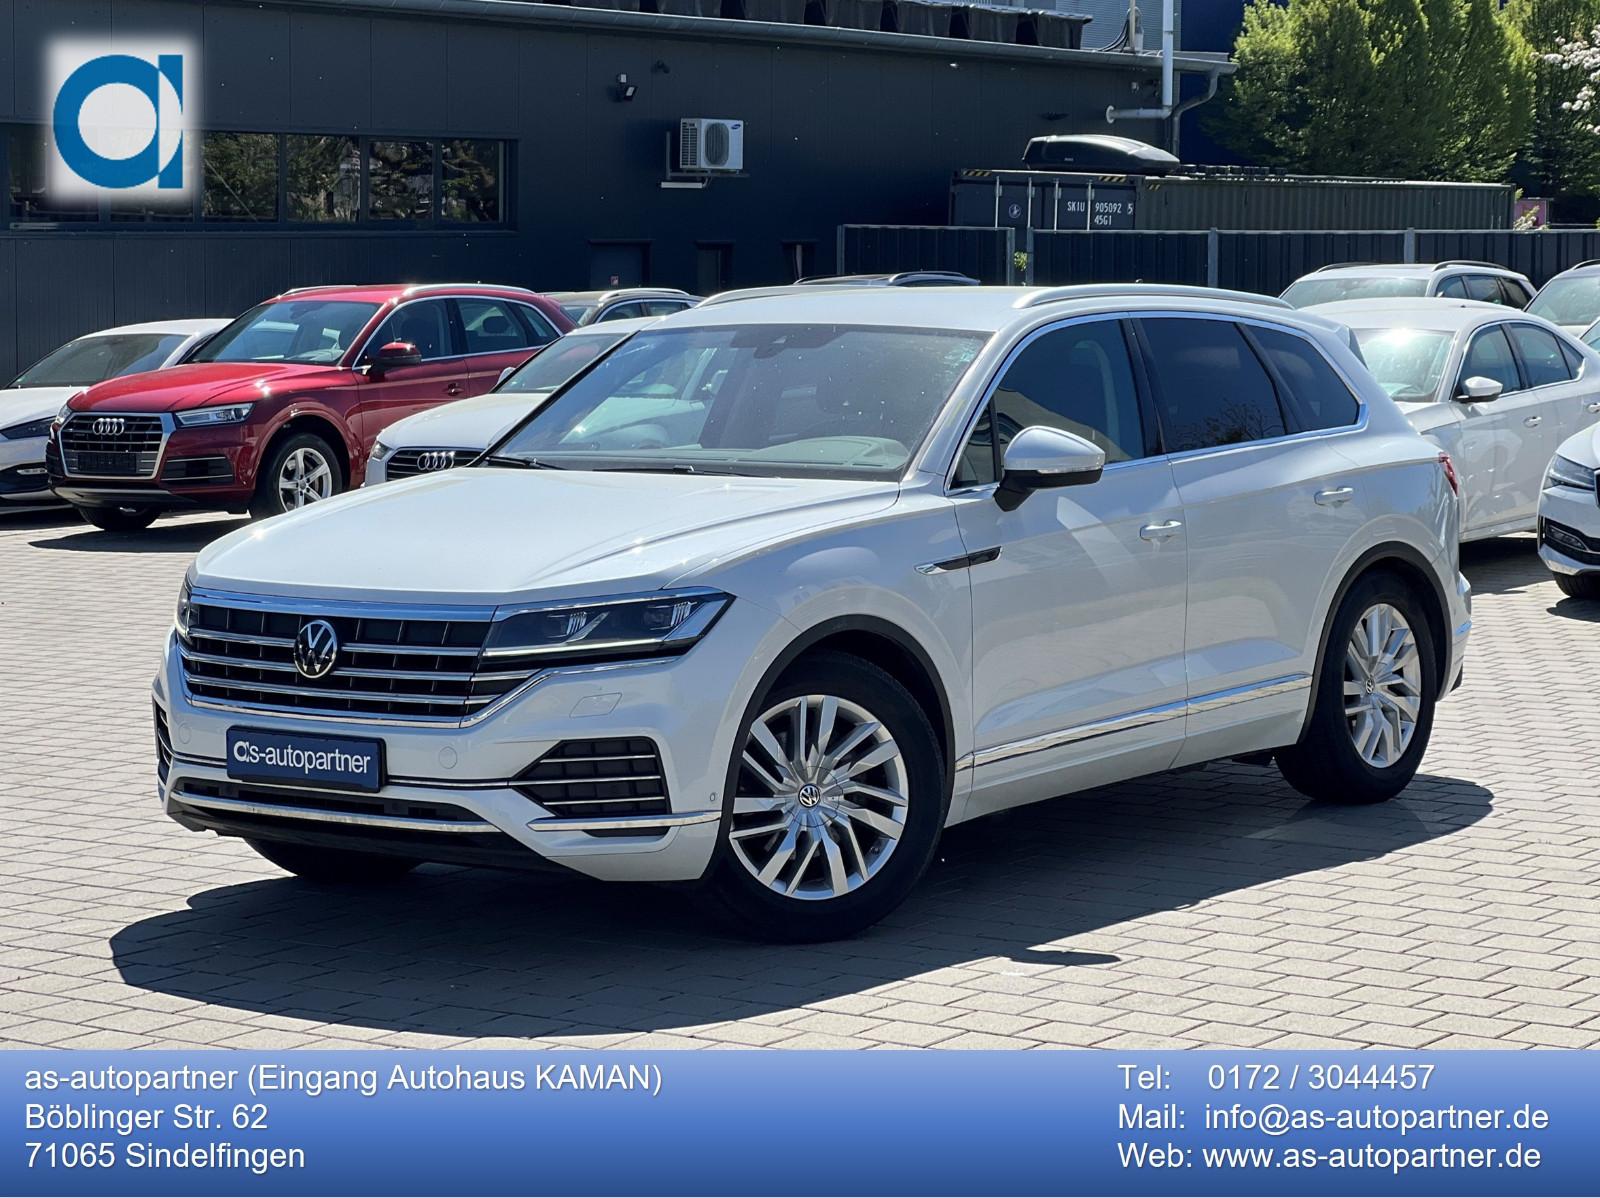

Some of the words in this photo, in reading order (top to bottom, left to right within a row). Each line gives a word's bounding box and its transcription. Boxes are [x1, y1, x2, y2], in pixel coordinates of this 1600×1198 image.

[1095, 202, 1122, 214] 905092
[1127, 203, 1134, 215] 5
[233, 740, 371, 774] as-autopartner
